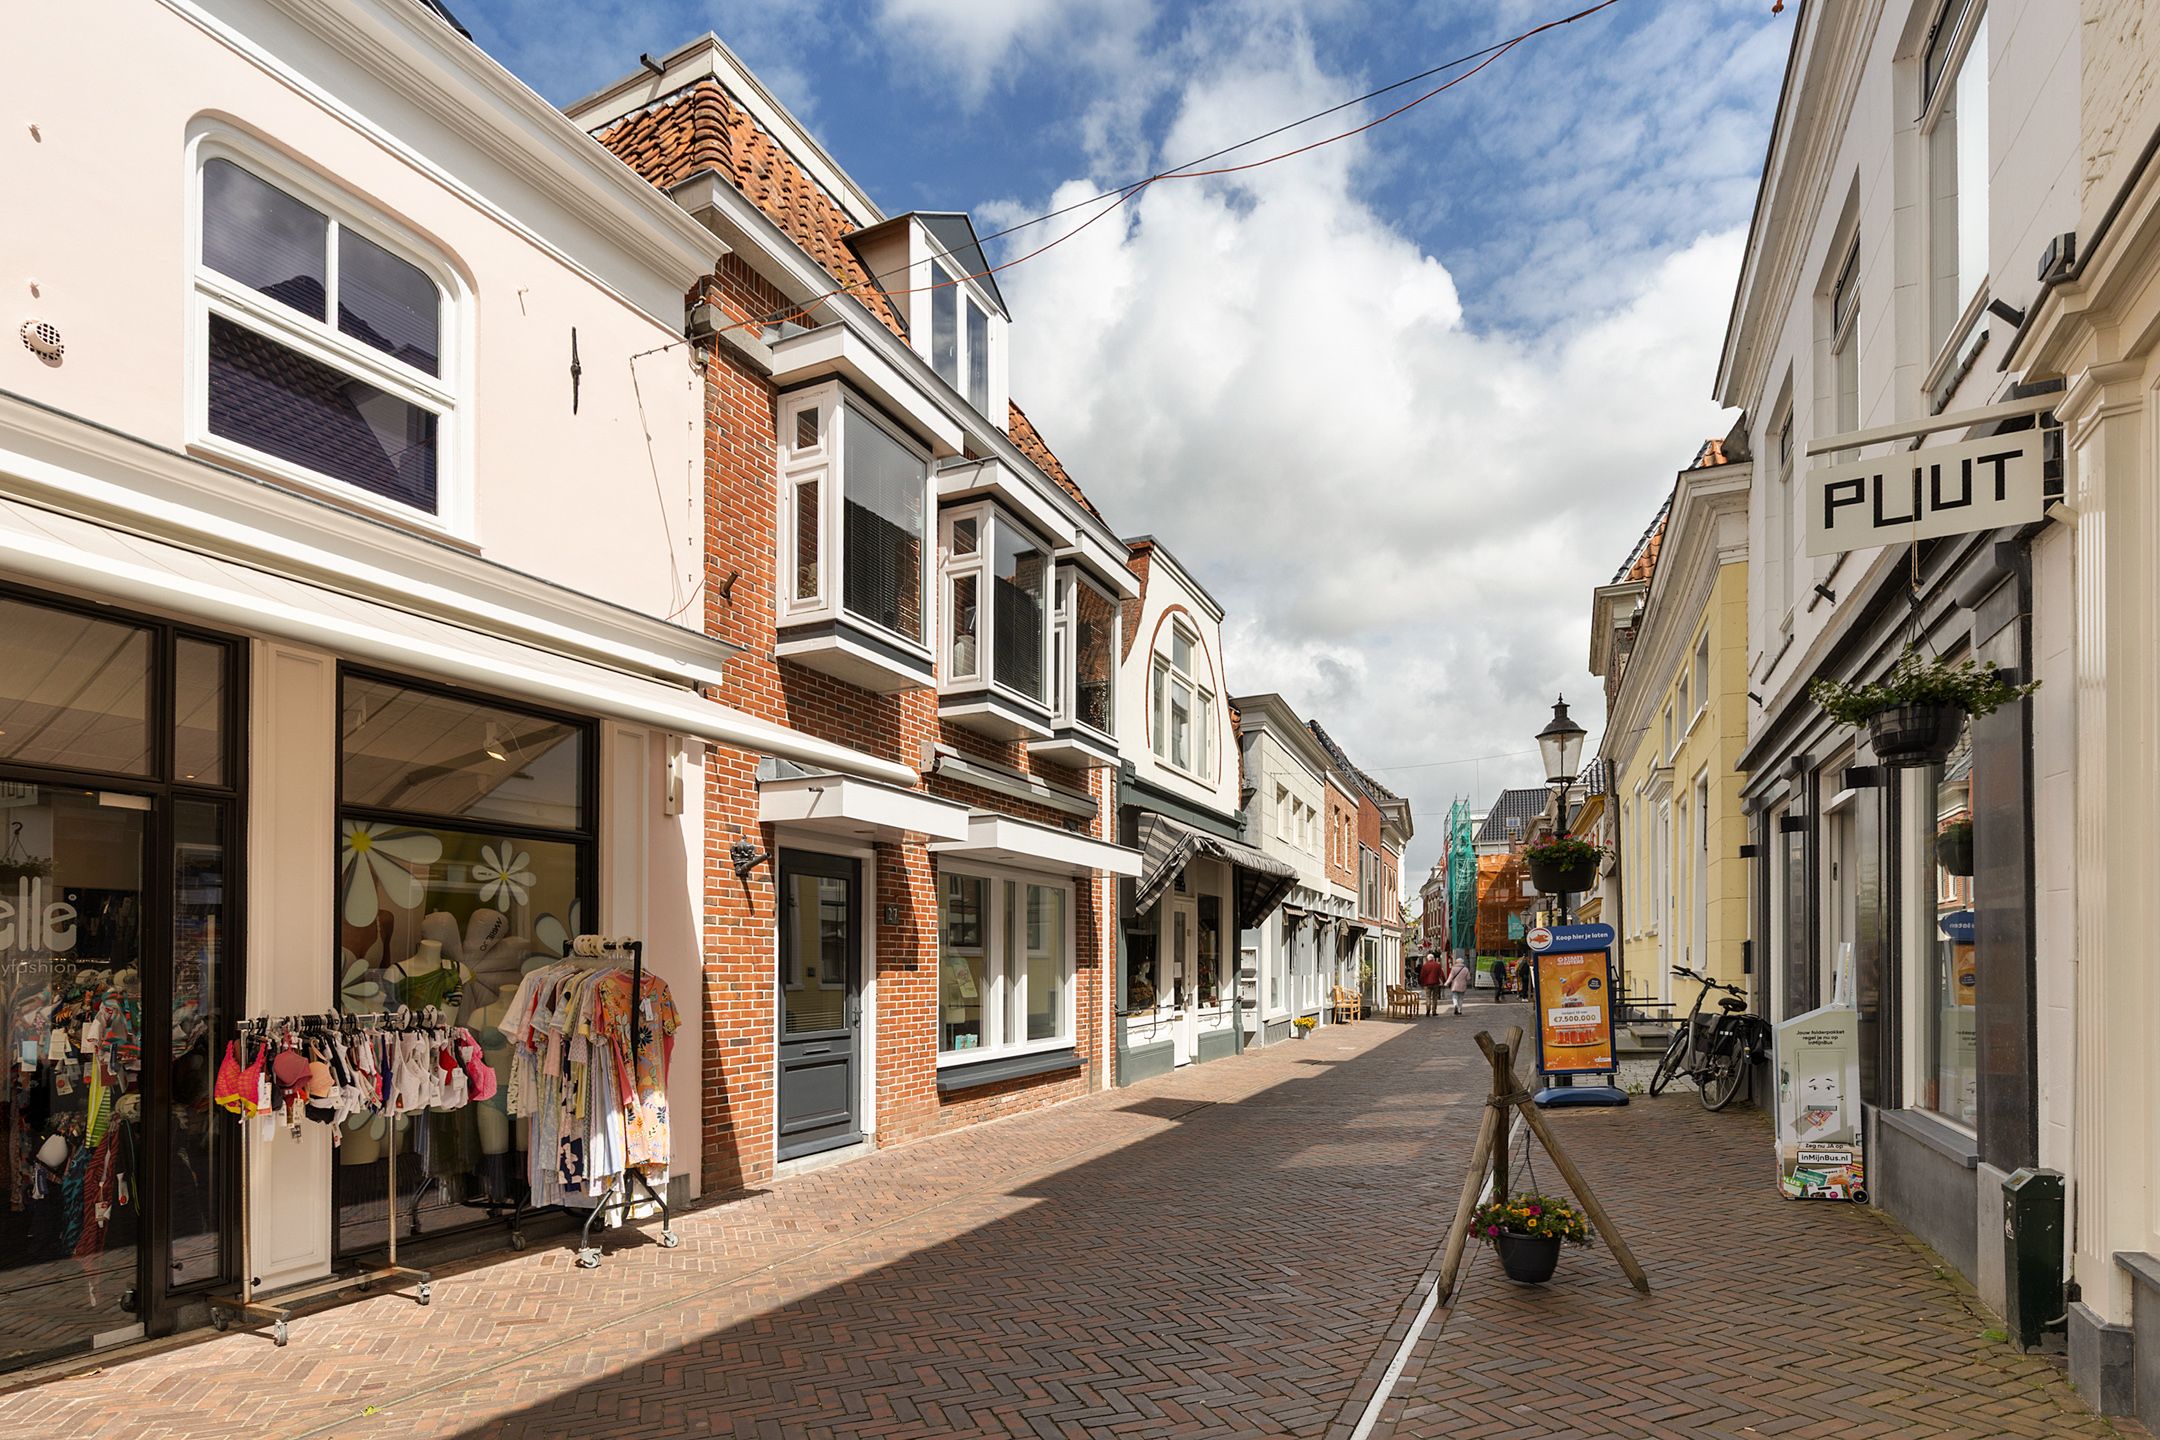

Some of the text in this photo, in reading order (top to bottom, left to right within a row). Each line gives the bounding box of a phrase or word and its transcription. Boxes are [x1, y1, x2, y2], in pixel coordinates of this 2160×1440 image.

[1824, 449, 2024, 530] PUUT
[888, 906, 898, 920] 27
[1554, 1014, 1596, 1022] €7.500.000
